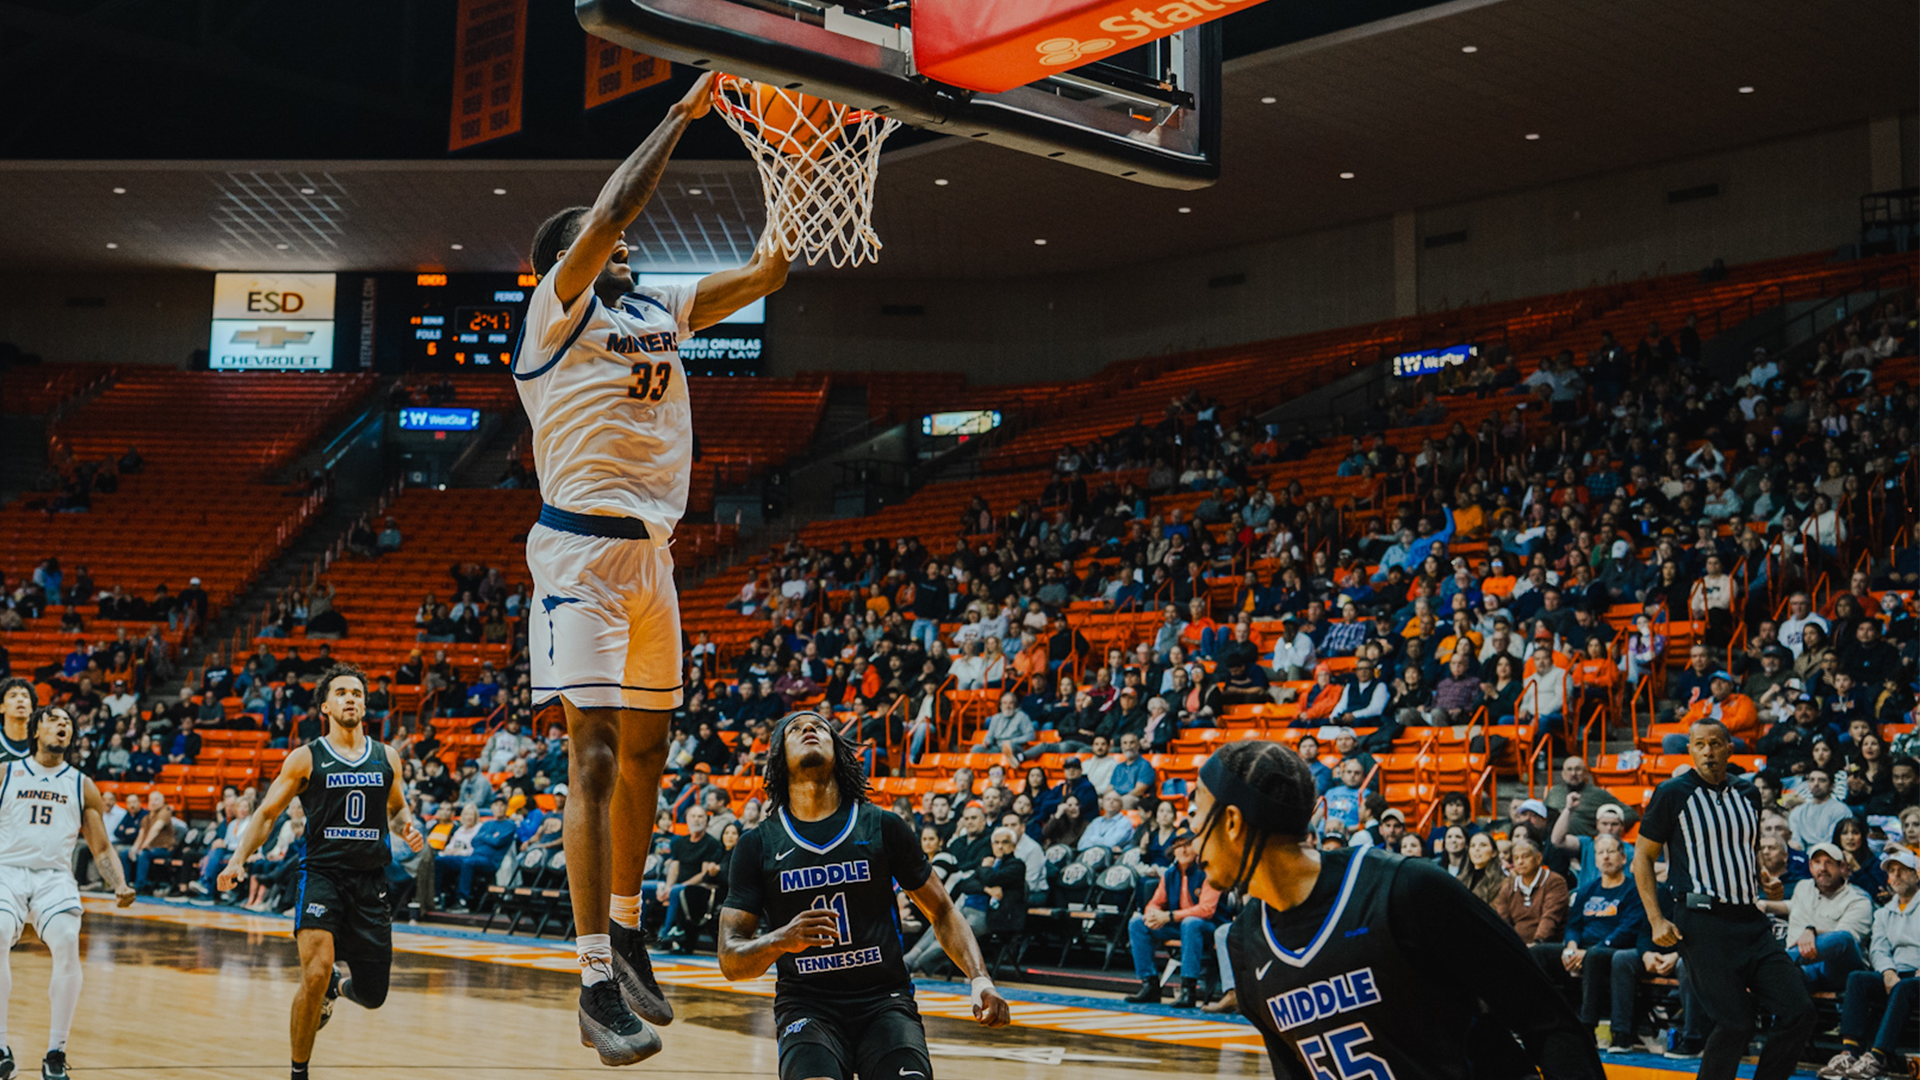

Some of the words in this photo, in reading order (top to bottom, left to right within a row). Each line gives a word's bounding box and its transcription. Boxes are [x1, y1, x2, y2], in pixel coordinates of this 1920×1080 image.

[1100, 0, 1246, 40] Stat
[247, 291, 304, 313] ESD
[494, 291, 524, 302] PERIOD
[469, 311, 510, 331] 2:47
[415, 328, 442, 340] FOULS
[709, 337, 762, 350] ORNELAS
[426, 341, 437, 356] 6
[679, 350, 725, 360] NJURY
[727, 350, 761, 360] LAW
[221, 355, 320, 366] CHEVROLET
[628, 361, 672, 402] 33
[326, 772, 384, 789] MIDDLE
[17, 790, 68, 804] MINERS
[29, 804, 53, 825] 15
[344, 790, 366, 825] 0
[324, 826, 380, 841] TENNESSEE
[780, 860, 871, 893] MIDDLE
[795, 946, 882, 975] TENNESSEE
[1266, 967, 1382, 1032] MIDDLE
[1296, 1021, 1397, 1080] 55
